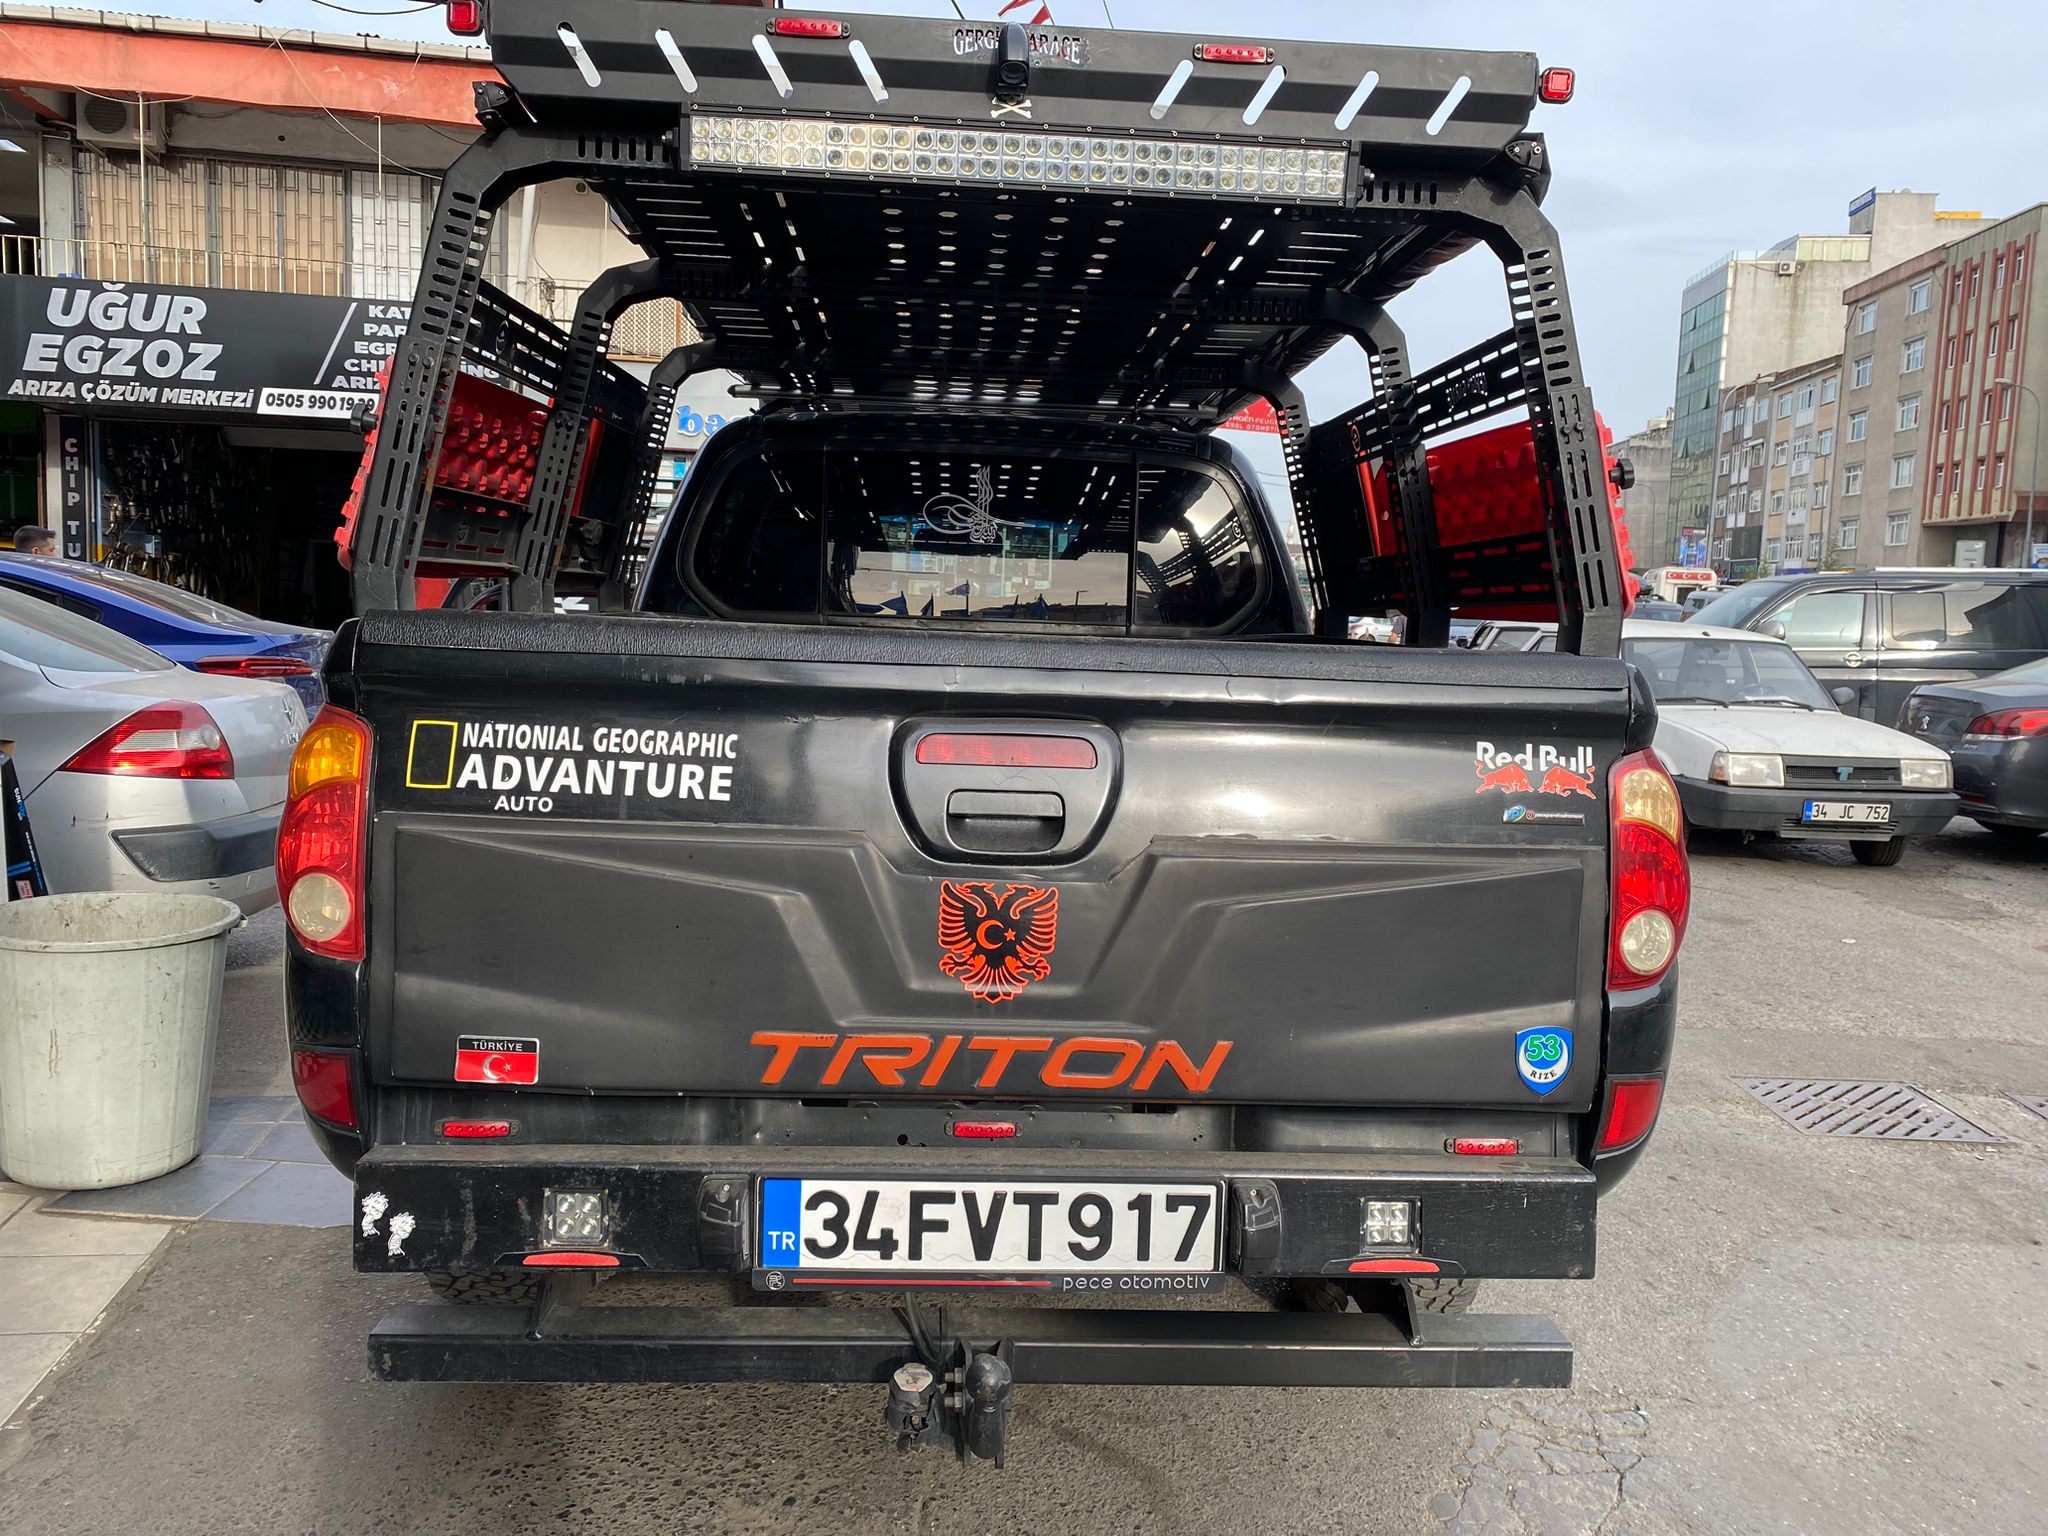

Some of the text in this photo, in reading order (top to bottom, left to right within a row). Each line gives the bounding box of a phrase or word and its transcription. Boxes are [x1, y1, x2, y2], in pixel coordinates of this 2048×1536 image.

[1029, 33, 1081, 64] ARAGE
[46, 282, 207, 334] UĞUR
[368, 305, 411, 319] KAT
[22, 333, 223, 381] EGZOZ
[7, 379, 255, 408] ARIZA ÇÖZÜM MERKEZİ
[331, 375, 381, 389] ARIZ
[265, 393, 304, 408] 0505
[308, 395, 337, 410] 990
[64, 437, 80, 507] CHIP
[462, 722, 738, 758] NATIONIAL GEOGRAPHIC
[1476, 741, 1593, 774] Red Bull
[456, 753, 733, 801] ADVANTURE
[493, 795, 553, 813] AUTO
[1812, 804, 1889, 820] 34 JC 752
[472, 1040, 523, 1051] TÜRKİYE
[1525, 1034, 1561, 1062] 53
[750, 1032, 1234, 1092] TRITON
[768, 1230, 796, 1251] TR
[1062, 1275, 1210, 1292] pece otomotiv
